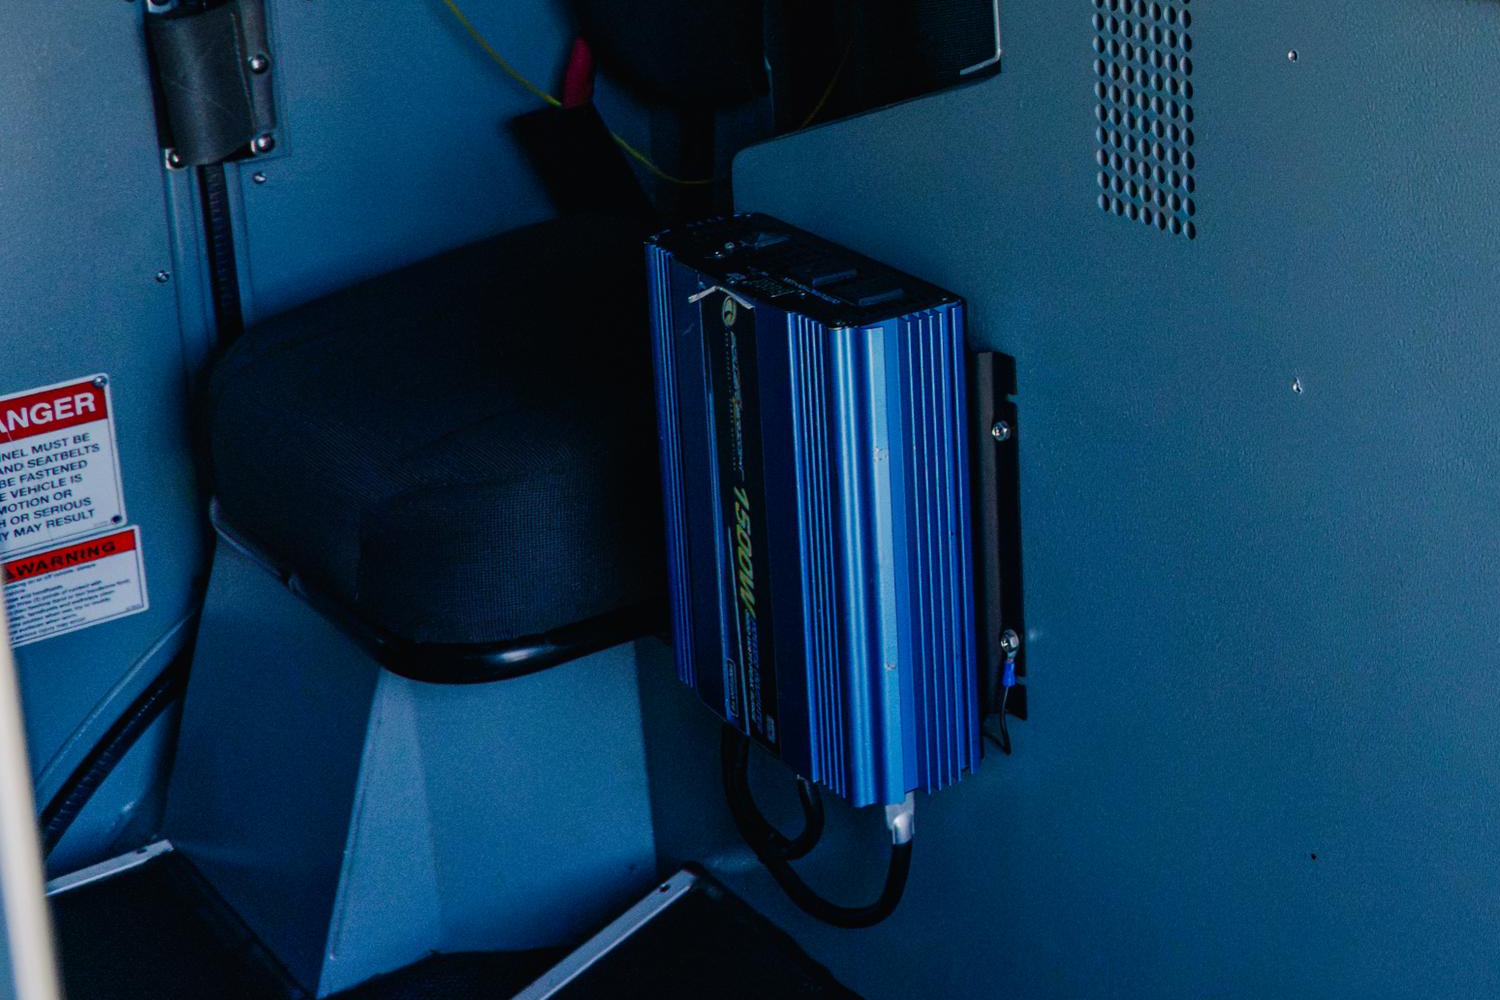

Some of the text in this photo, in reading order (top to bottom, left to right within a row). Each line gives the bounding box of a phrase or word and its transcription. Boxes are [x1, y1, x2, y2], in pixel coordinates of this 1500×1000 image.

[0, 432, 91, 463] NEL MUST BE
[27, 442, 101, 469] SEATBELTS
[10, 478, 66, 498] VEHICLE
[70, 473, 84, 485] IS
[19, 459, 89, 484] FASTENED
[53, 488, 73, 502] OR
[10, 513, 30, 526] OR
[33, 496, 93, 520] SERIOUS
[13, 522, 43, 539] MAY
[45, 508, 96, 530] RESULT
[17, 542, 116, 576] WARNING
[733, 485, 759, 620] 1500W
